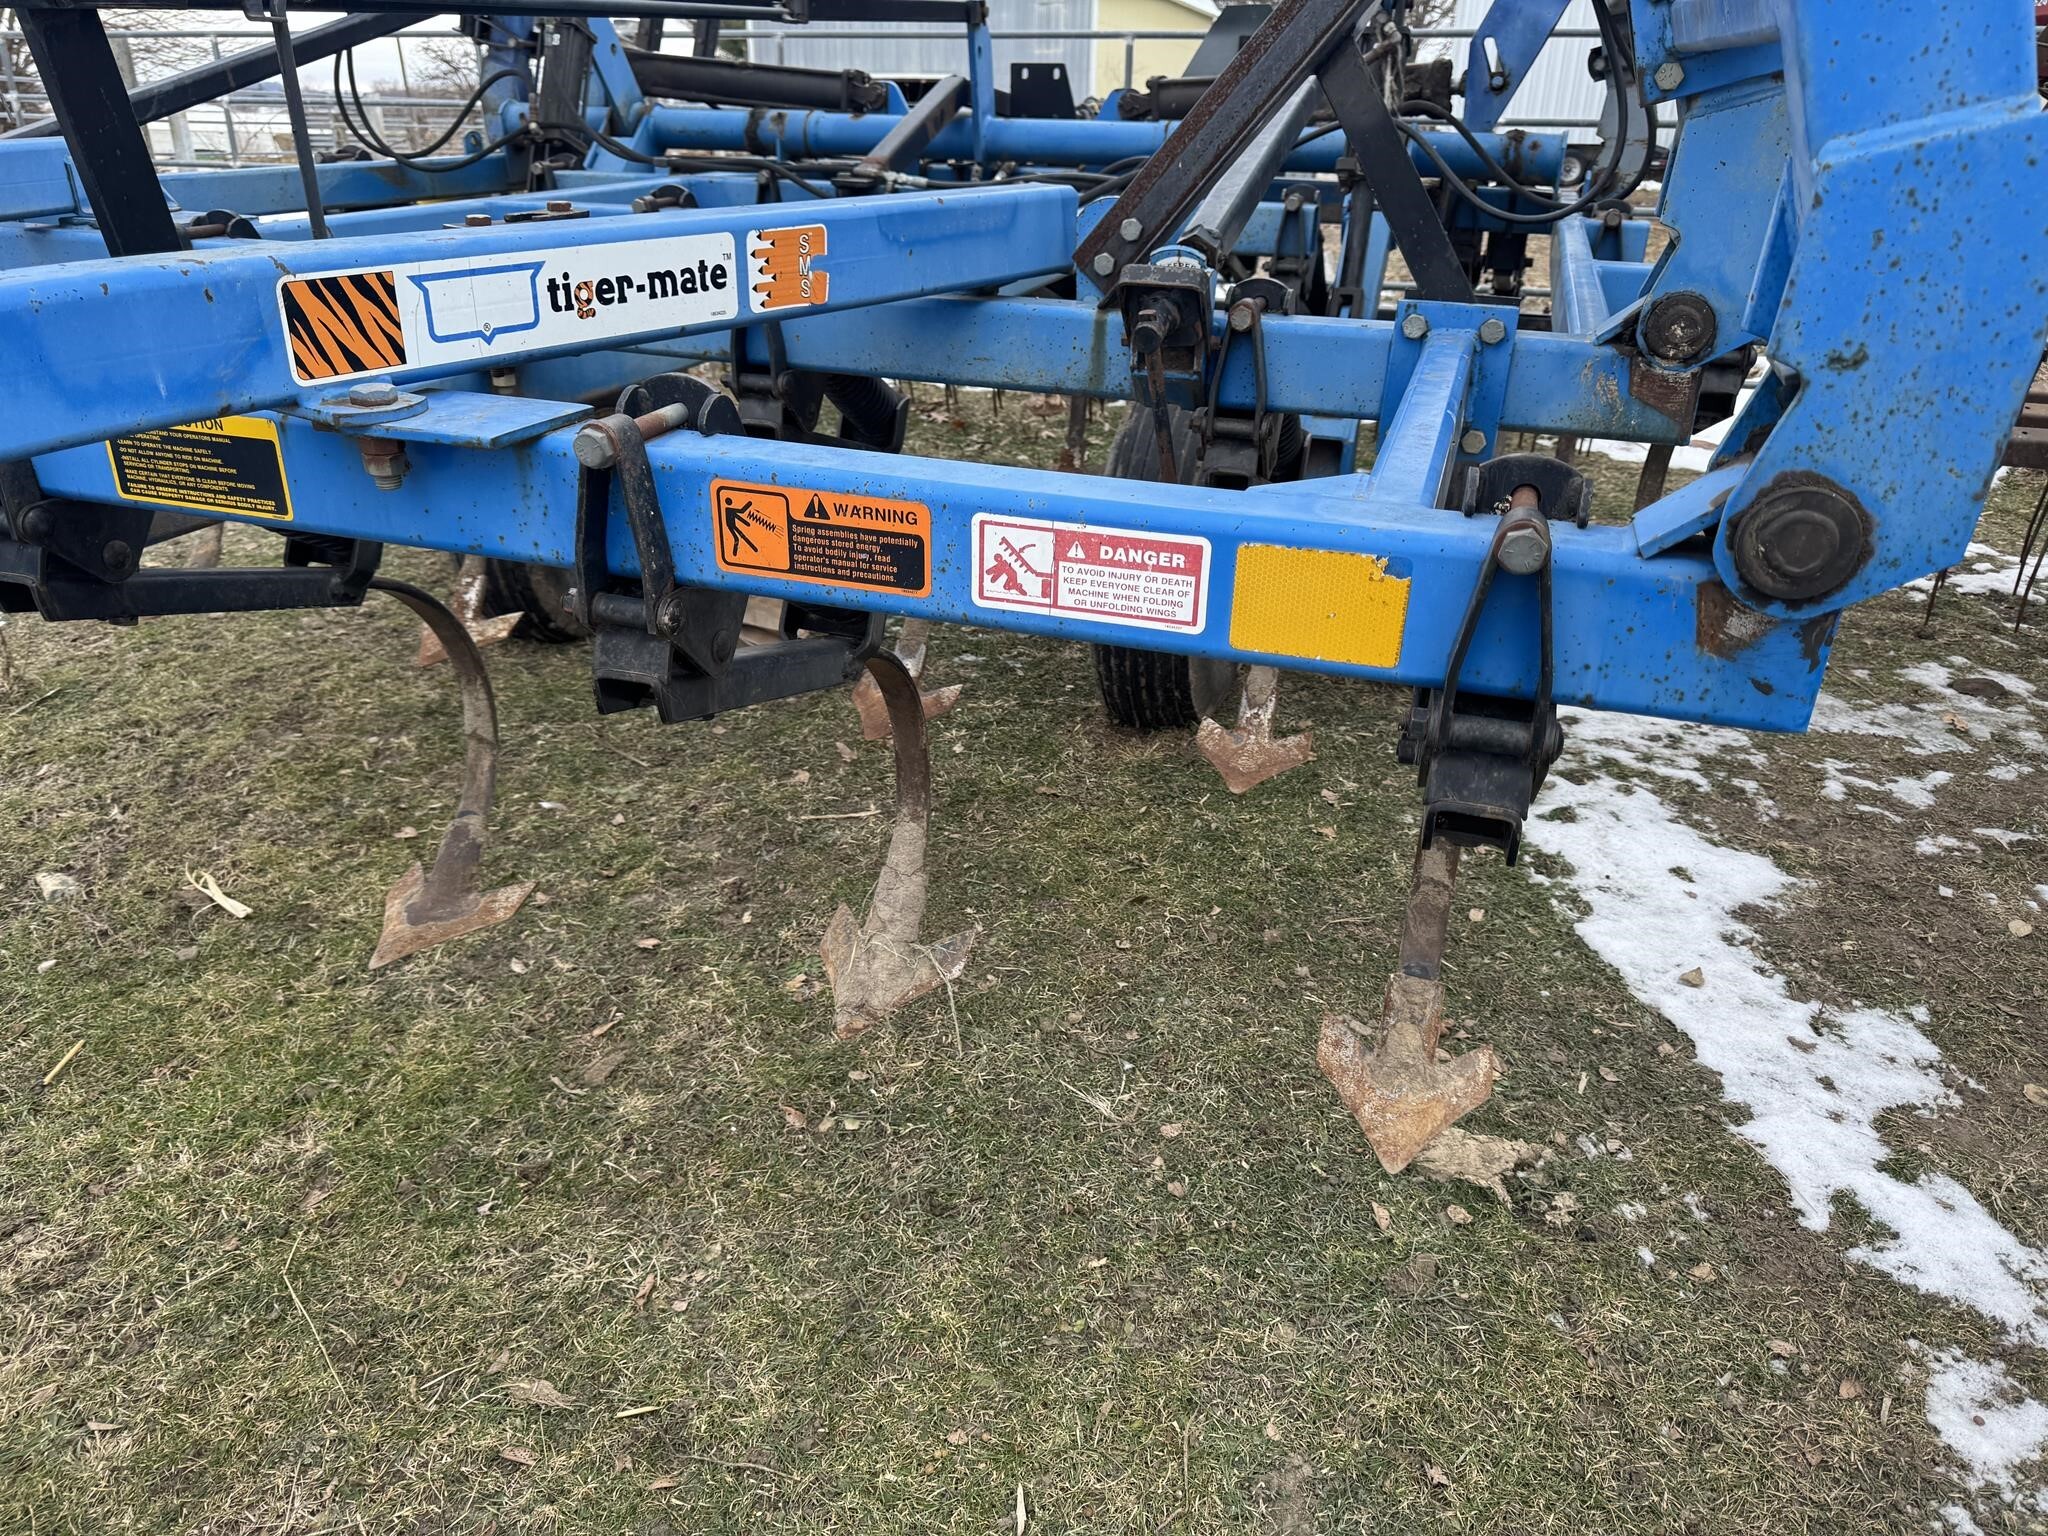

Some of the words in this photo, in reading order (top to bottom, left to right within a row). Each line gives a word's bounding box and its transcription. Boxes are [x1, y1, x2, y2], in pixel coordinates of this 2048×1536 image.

[798, 233, 812, 298] SMS
[547, 259, 728, 320] tiger-mate
[833, 502, 918, 526] WARNING
[792, 524, 816, 536] Spring
[817, 528, 858, 540] assemblies
[860, 533, 877, 542] have
[879, 536, 918, 549] potentially
[792, 534, 830, 546] dangerous
[831, 540, 854, 549] stored
[856, 542, 883, 553] energy.
[793, 543, 802, 552] To
[804, 546, 823, 554] avoid
[825, 548, 847, 559] bodily
[874, 554, 891, 563] read
[793, 553, 830, 565] operator's
[831, 559, 858, 568] manual
[860, 560, 870, 570] for
[871, 564, 898, 573] service
[1100, 545, 1186, 569] DANGER
[794, 562, 835, 575] instructions
[837, 568, 850, 576] and
[852, 570, 897, 583] precautions.
[1062, 565, 1074, 574] TO
[1077, 567, 1106, 578] AVOID
[1108, 571, 1142, 582] INJURY
[1144, 575, 1158, 584] OR
[1161, 577, 1193, 588] DEATH
[1063, 576, 1088, 586] KEEP
[1090, 579, 1140, 593] EVERYONE
[1143, 586, 1174, 597] CLEAR
[1177, 590, 1190, 598] OF
[1068, 587, 1110, 599] MACHINE
[1112, 593, 1140, 603] WHEN
[1143, 596, 1184, 608] FOLDING
[1073, 598, 1087, 607] OR
[1090, 600, 1143, 614] UNFOLDING
[1146, 607, 1177, 618] WINGS
